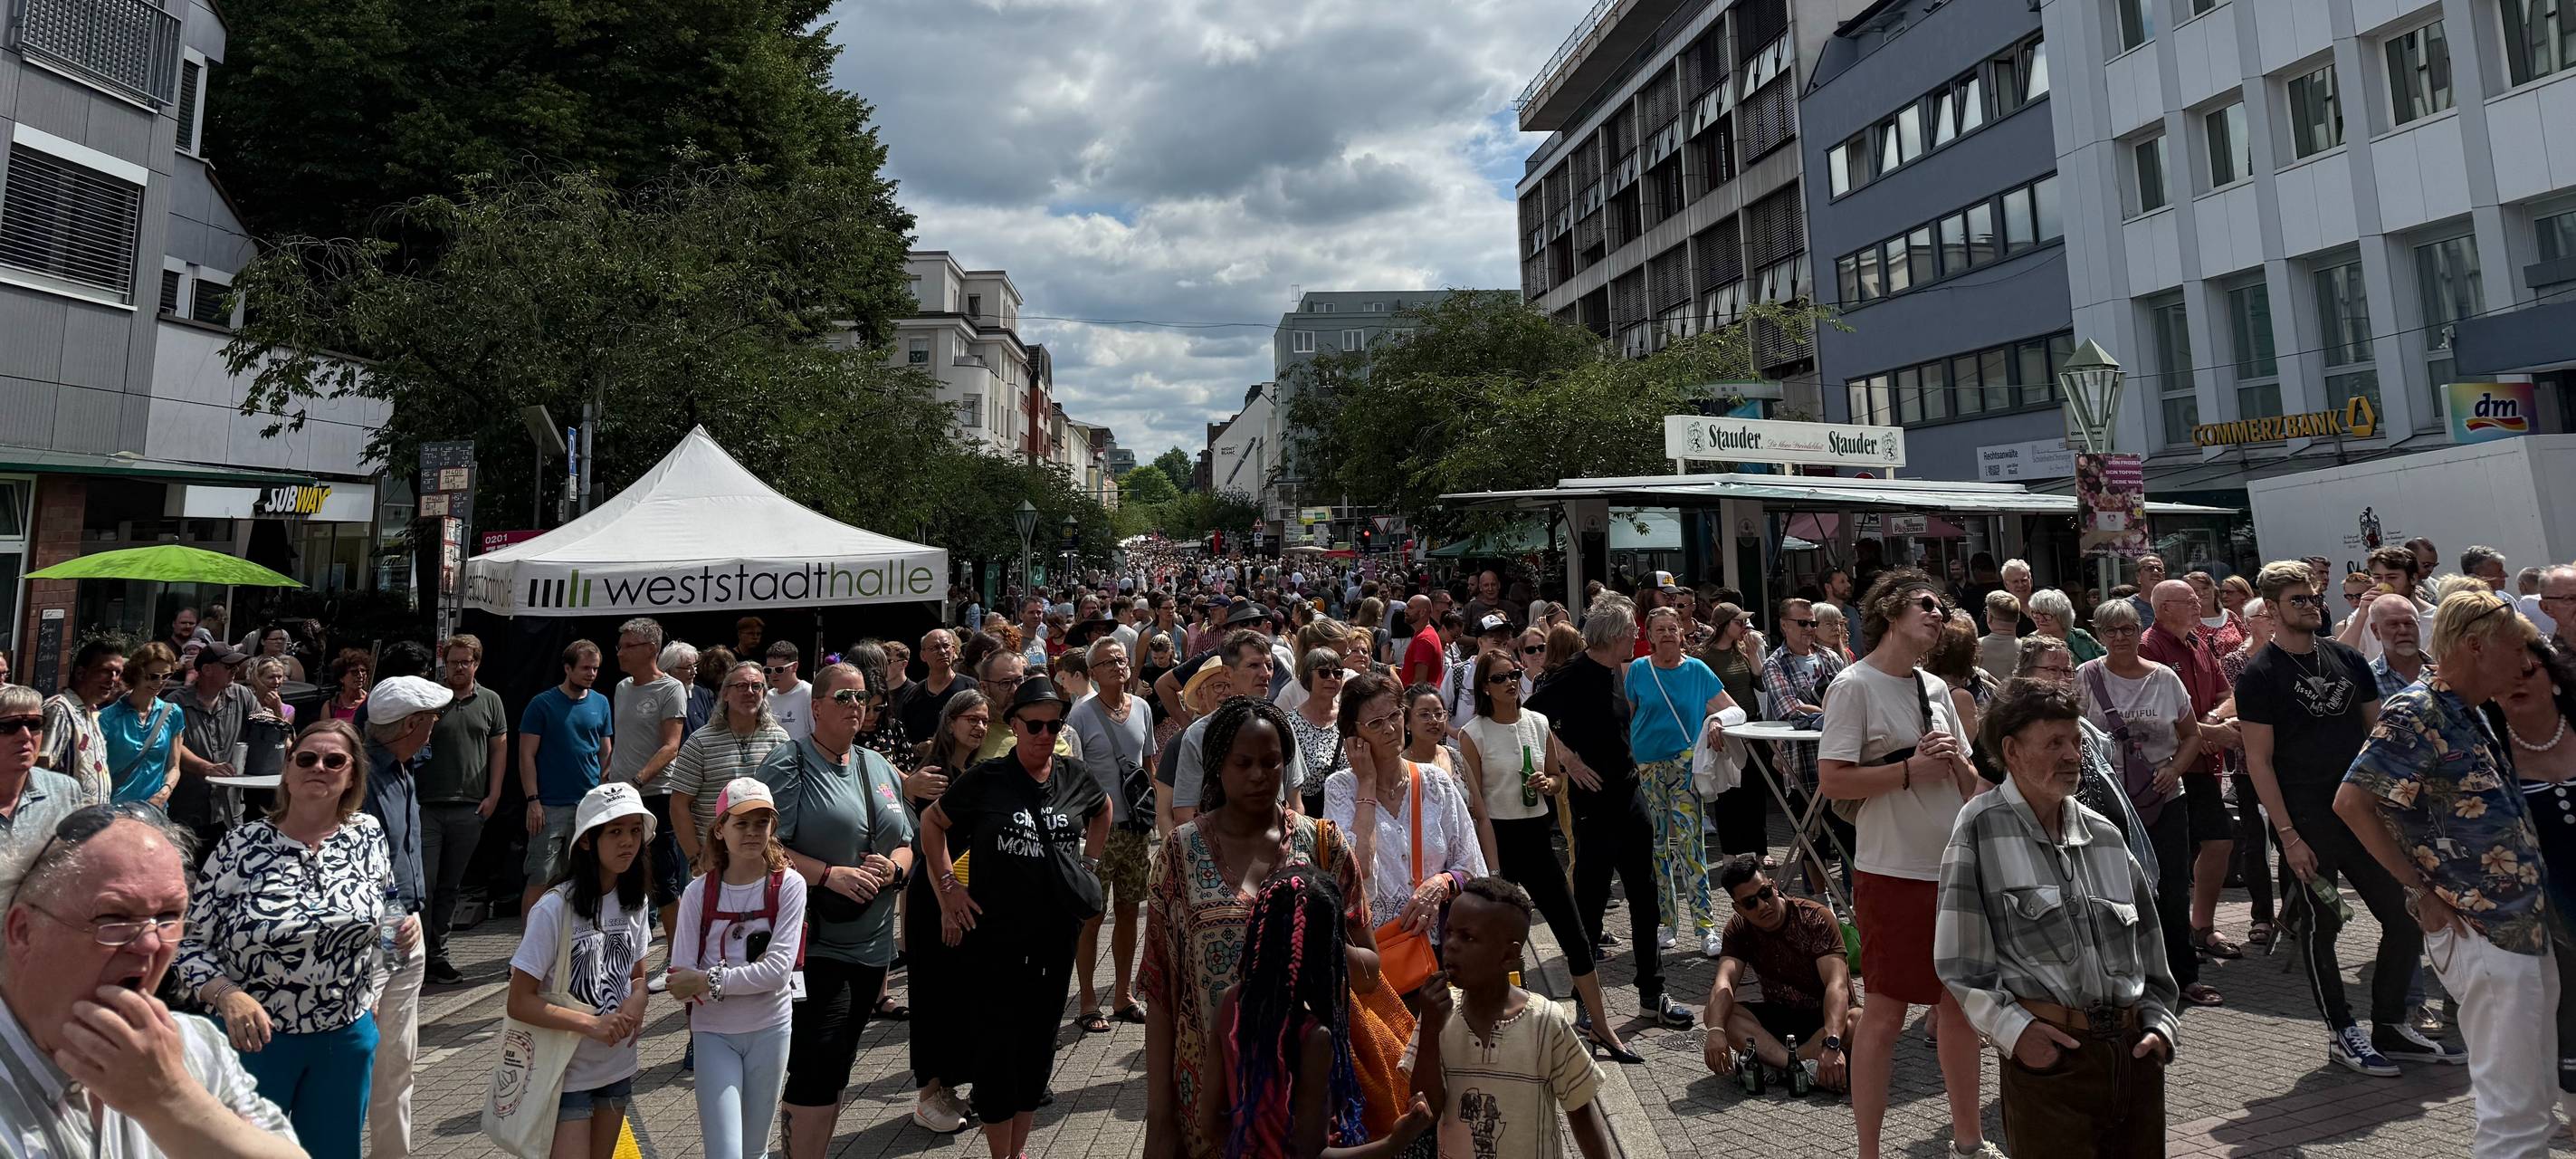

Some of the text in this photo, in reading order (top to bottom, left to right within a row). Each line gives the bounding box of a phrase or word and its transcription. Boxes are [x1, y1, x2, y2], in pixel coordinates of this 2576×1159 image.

[2475, 392, 2518, 418] dm
[2191, 409, 2343, 445] COMMERZBANK
[1983, 449, 2018, 461] Rechtsanwälte
[264, 485, 332, 514] SUBWAY
[485, 533, 508, 544] 0201
[603, 559, 935, 607] weststadthalle
[2120, 709, 2158, 719] AUTIFUL
[606, 795, 626, 803] adidas
